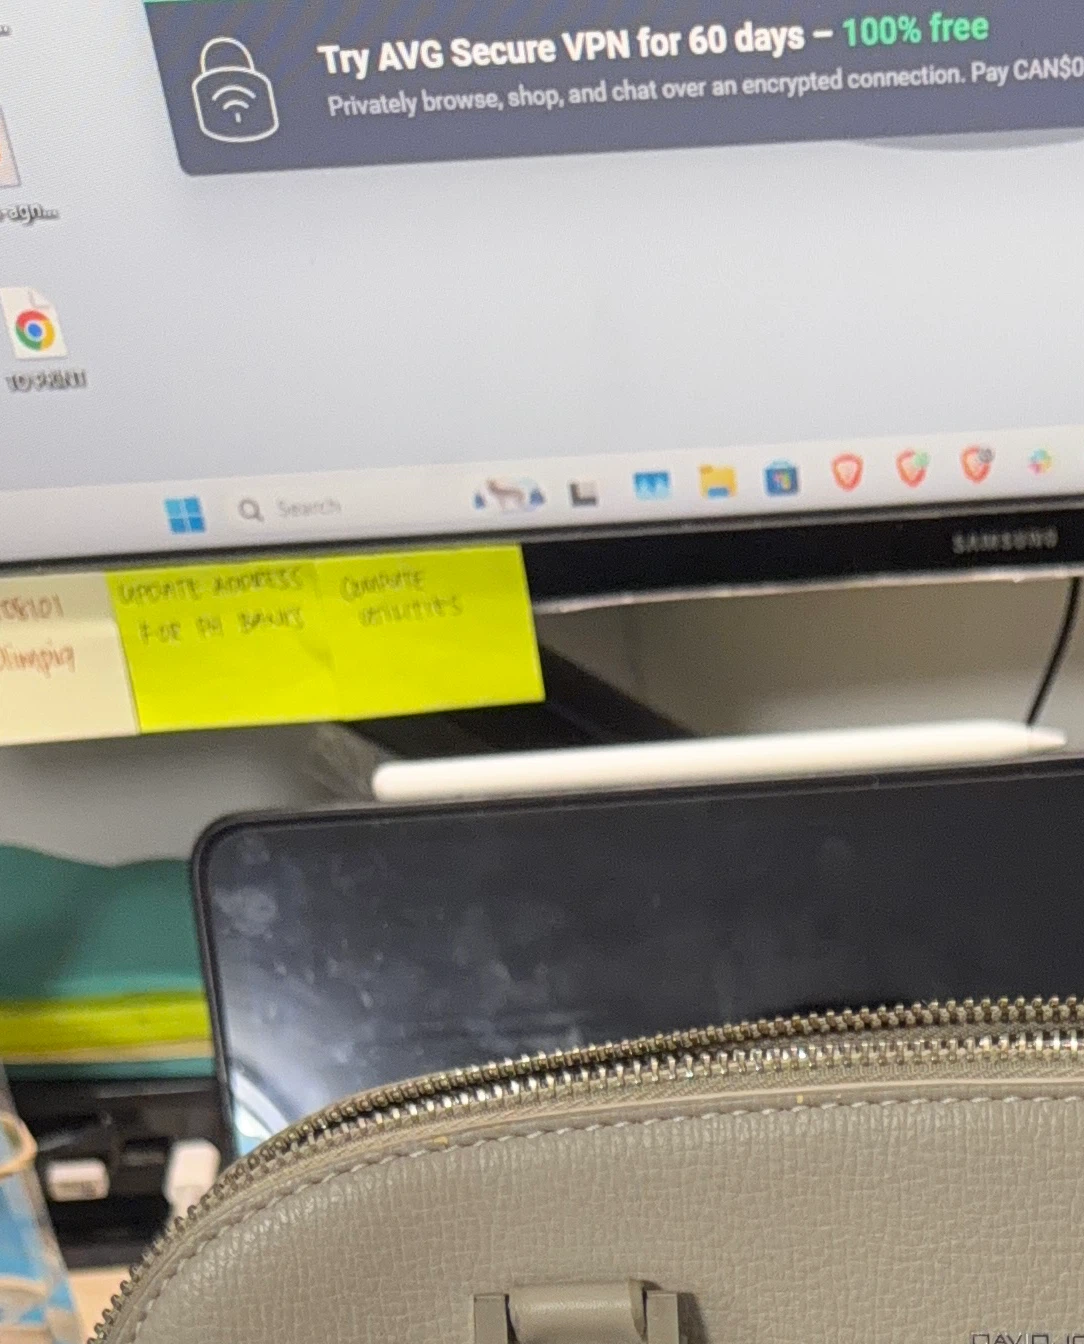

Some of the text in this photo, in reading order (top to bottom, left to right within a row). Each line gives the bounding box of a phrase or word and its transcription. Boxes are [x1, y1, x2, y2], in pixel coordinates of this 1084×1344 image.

[317, 44, 369, 80] Try
[378, 39, 444, 71] AVG
[451, 37, 556, 67] Secure
[562, 28, 630, 61] VPN
[636, 26, 682, 57] for
[688, 24, 727, 54] 60
[734, 21, 805, 58] days
[842, 15, 922, 47] 100%
[930, 11, 990, 42] free
[327, 90, 417, 118] Privately
[421, 88, 504, 112] browse,
[510, 83, 564, 110] shop,
[568, 79, 607, 104] and
[611, 78, 657, 102] chat
[661, 79, 706, 100] over
[711, 76, 738, 96] an
[742, 67, 843, 97] encrypted
[847, 62, 966, 89] connection.
[971, 60, 1009, 86] Pay
[276, 498, 343, 518] Search
[951, 528, 1060, 555] SAMSUNG
